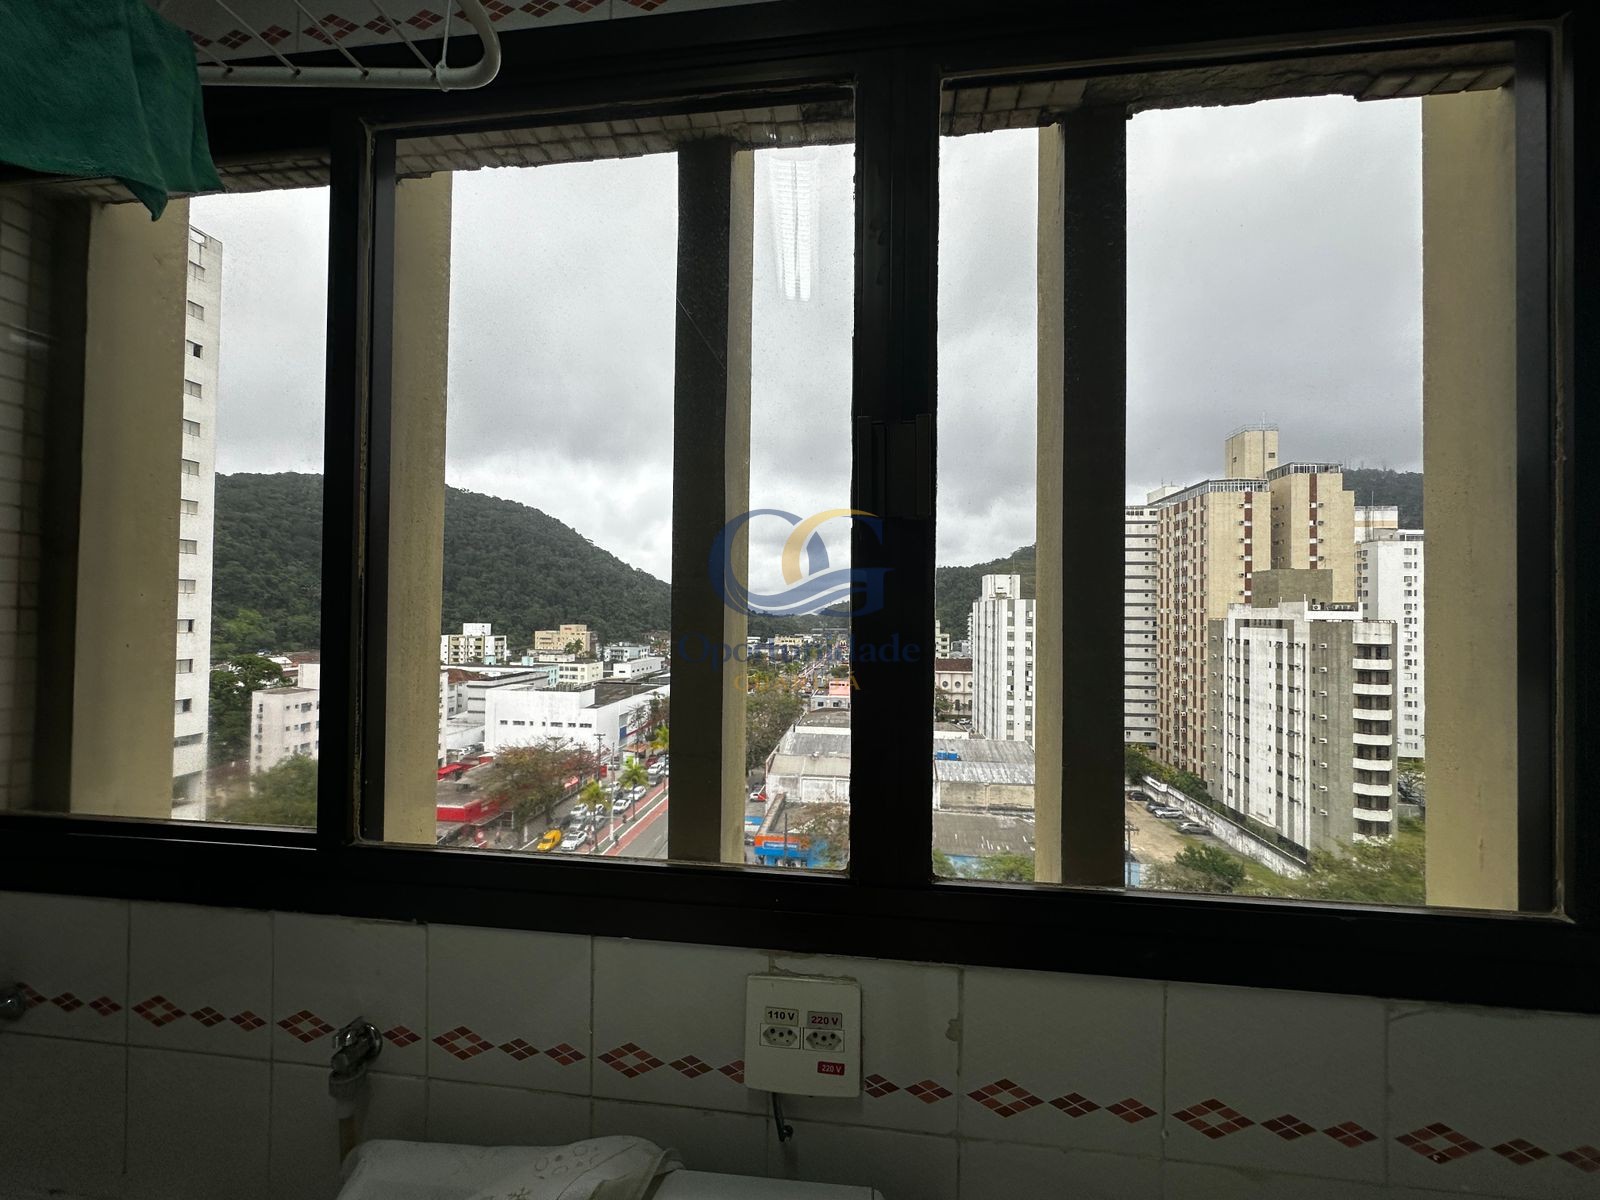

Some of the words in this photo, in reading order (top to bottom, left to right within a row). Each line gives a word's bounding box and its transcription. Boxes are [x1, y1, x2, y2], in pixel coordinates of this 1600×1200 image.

[768, 1011, 786, 1020] 110
[788, 1012, 795, 1020] V
[811, 1016, 829, 1025] 220
[831, 1017, 839, 1025] V
[821, 1064, 834, 1072] 220
[836, 1065, 842, 1073] V
